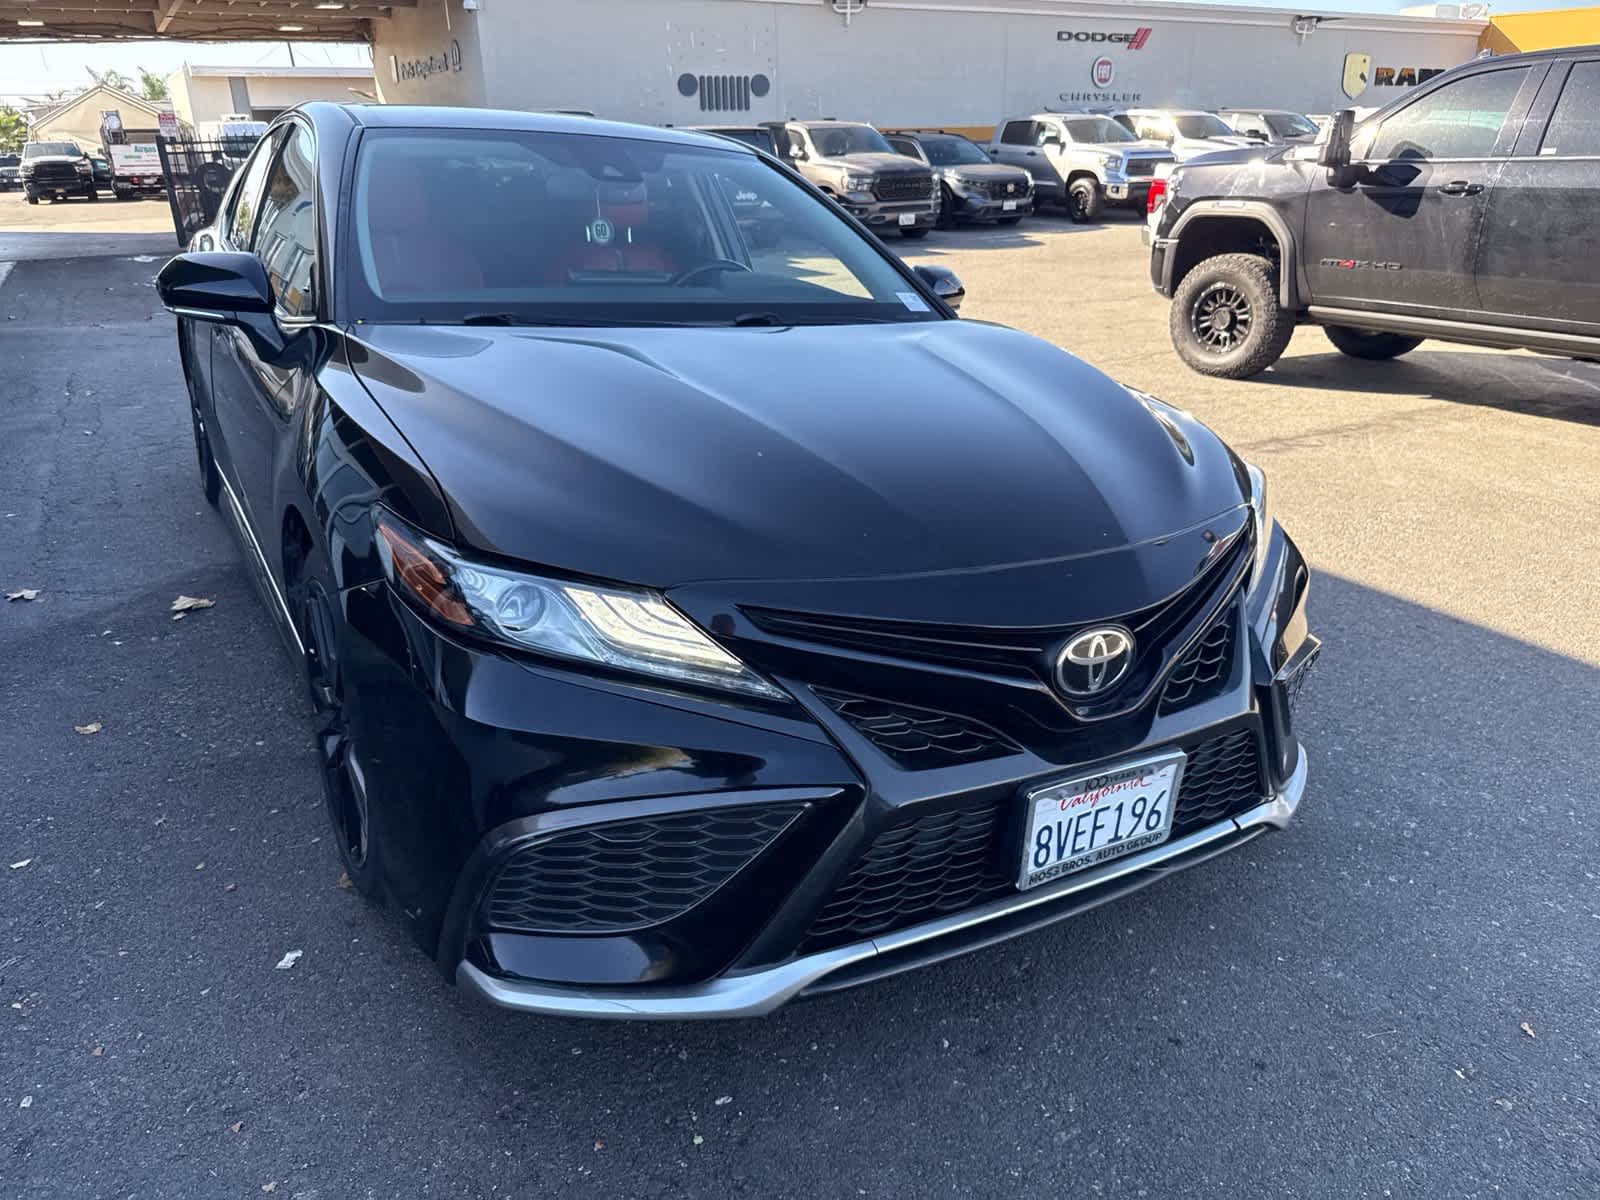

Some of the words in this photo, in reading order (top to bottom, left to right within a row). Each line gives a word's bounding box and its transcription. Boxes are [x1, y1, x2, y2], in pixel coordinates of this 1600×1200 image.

[1057, 31, 1136, 43] DODGE
[1059, 92, 1142, 103] CHRYSLER
[1032, 789, 1168, 869] 8VEF196
[1095, 845, 1125, 861] AUTO
